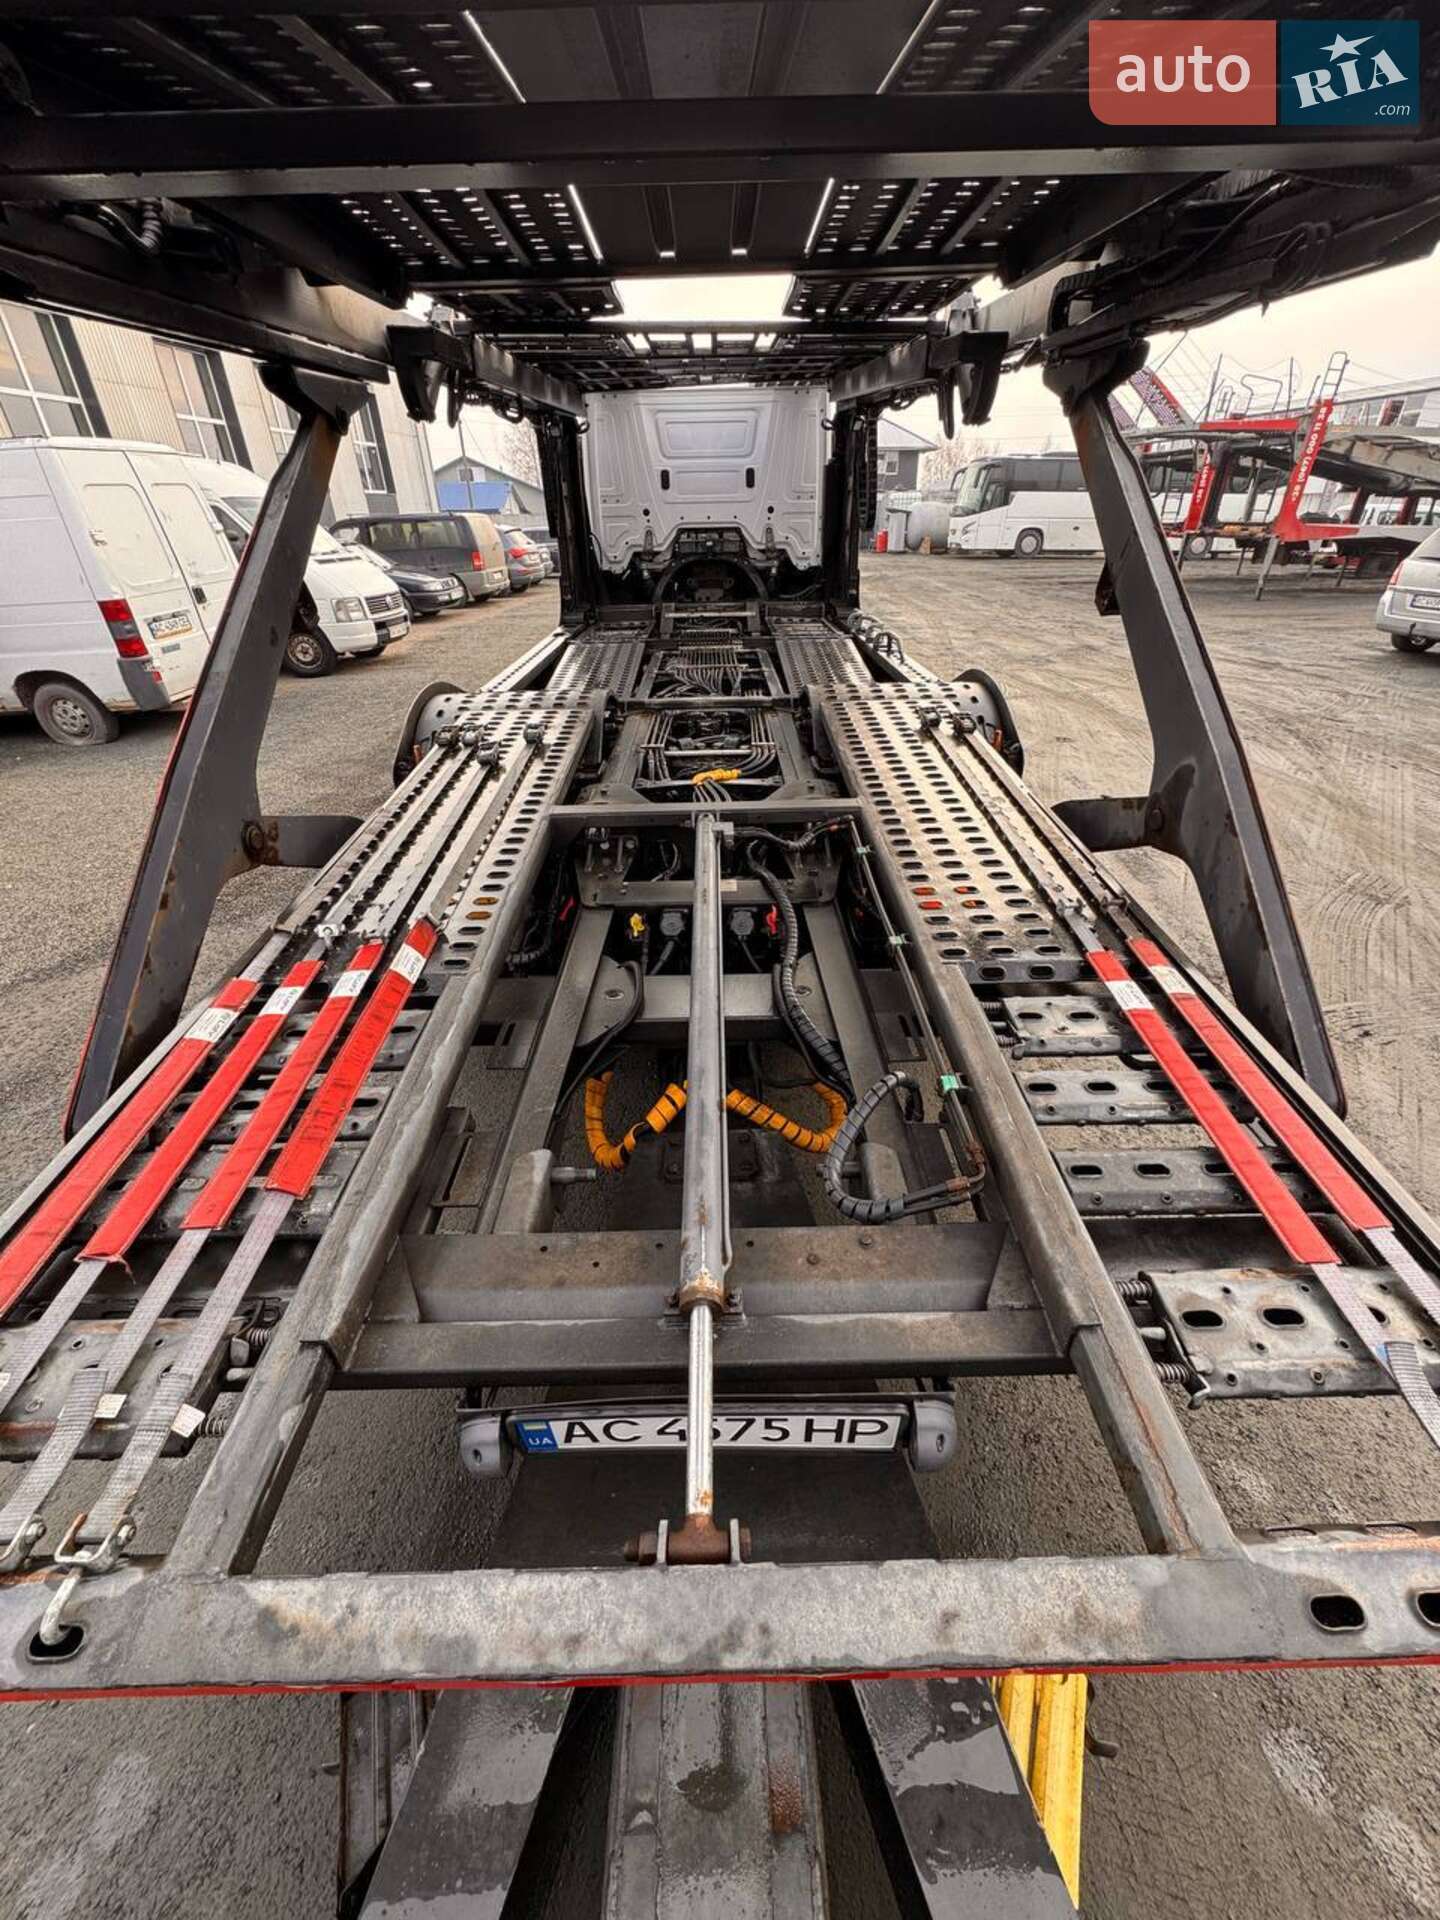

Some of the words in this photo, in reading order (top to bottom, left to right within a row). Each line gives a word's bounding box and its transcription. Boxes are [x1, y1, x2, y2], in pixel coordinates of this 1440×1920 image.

[564, 1419, 642, 1443] AC
[804, 1418, 889, 1443] HP
[528, 1437, 552, 1445] UA
